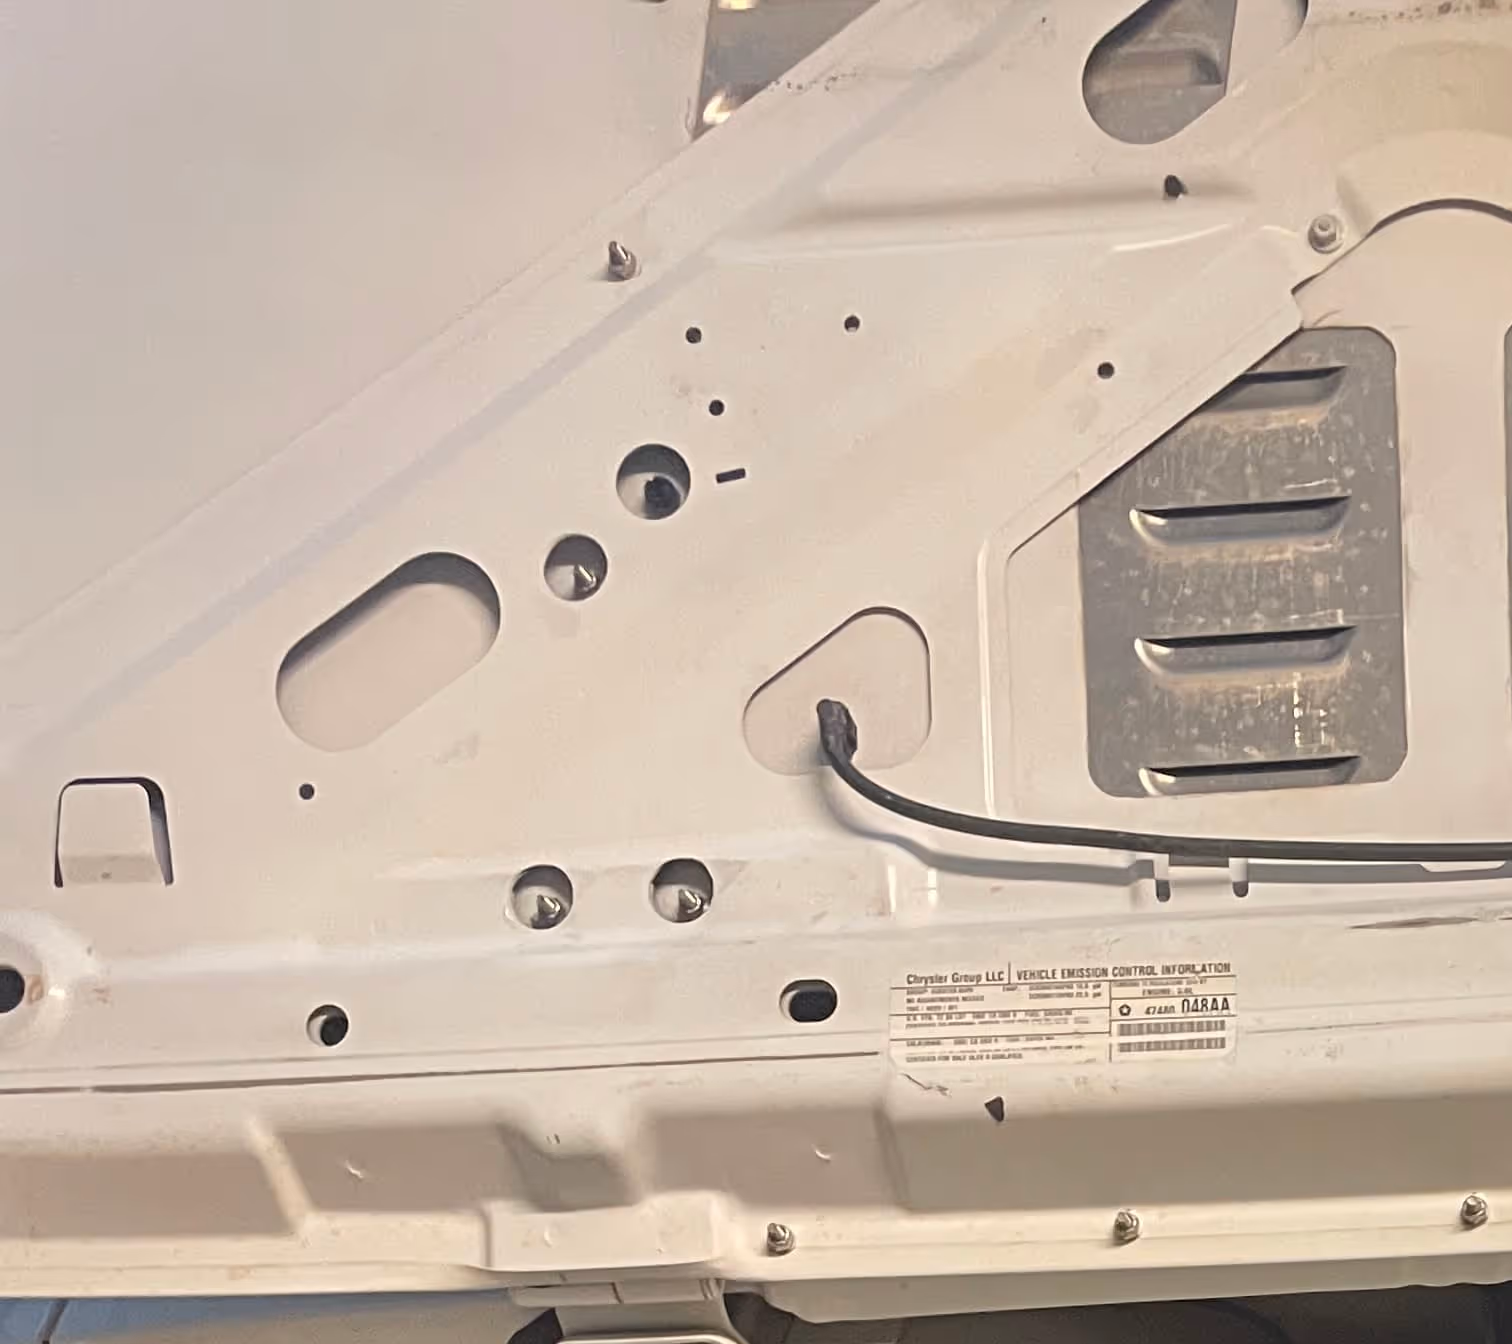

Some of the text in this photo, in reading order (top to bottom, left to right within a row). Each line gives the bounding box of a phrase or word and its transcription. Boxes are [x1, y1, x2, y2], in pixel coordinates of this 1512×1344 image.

[906, 973, 948, 985] Chrysler
[951, 972, 982, 985] Group
[985, 970, 1005, 982] LLC
[1016, 968, 1058, 981] VEHICLE
[1060, 967, 1109, 980] EMISSION
[1111, 965, 1158, 978] CONTROL
